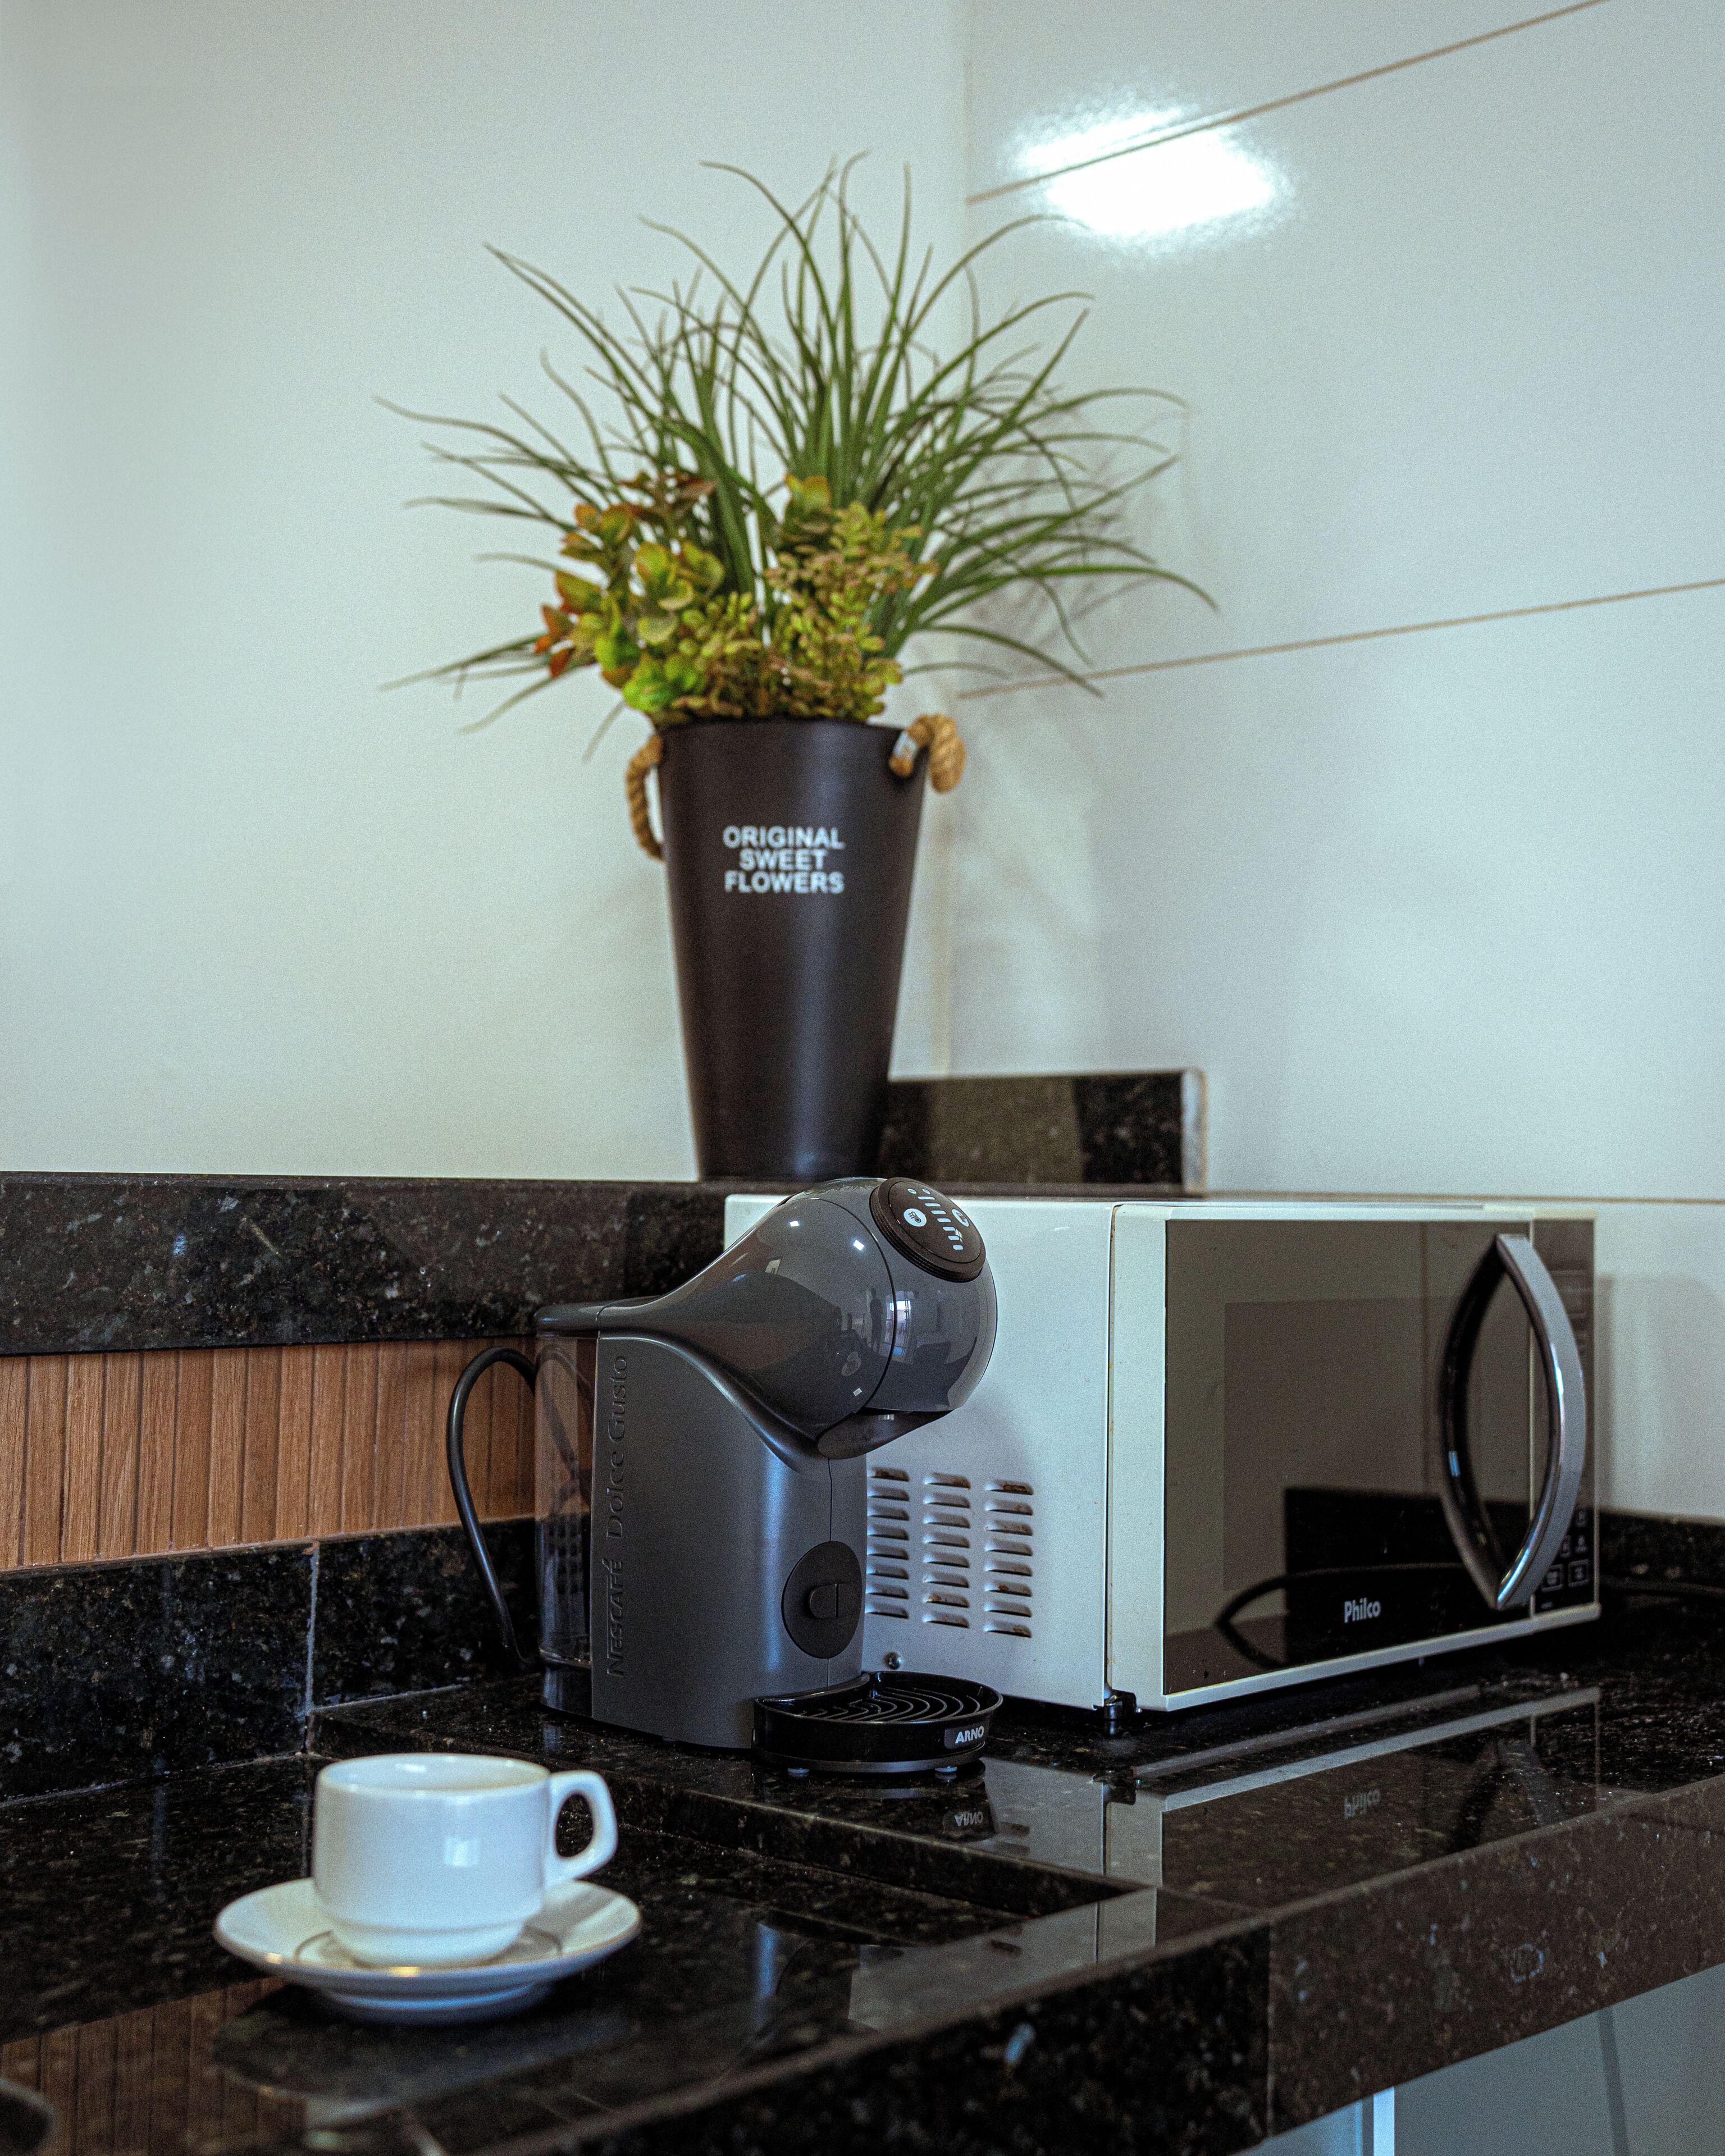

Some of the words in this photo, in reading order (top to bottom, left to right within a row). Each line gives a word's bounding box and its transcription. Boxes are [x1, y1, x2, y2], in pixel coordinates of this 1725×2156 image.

[723, 825, 845, 849] ORIGINAL
[739, 848, 829, 871] SWEET
[724, 870, 845, 894] FLOWERS
[608, 1355, 627, 1443] Gusto
[606, 1451, 624, 1540] Dolce
[601, 1557, 624, 1677] NESCAFÉ
[1344, 1597, 1381, 1624] Philco
[955, 1725, 984, 1744] ARNO
